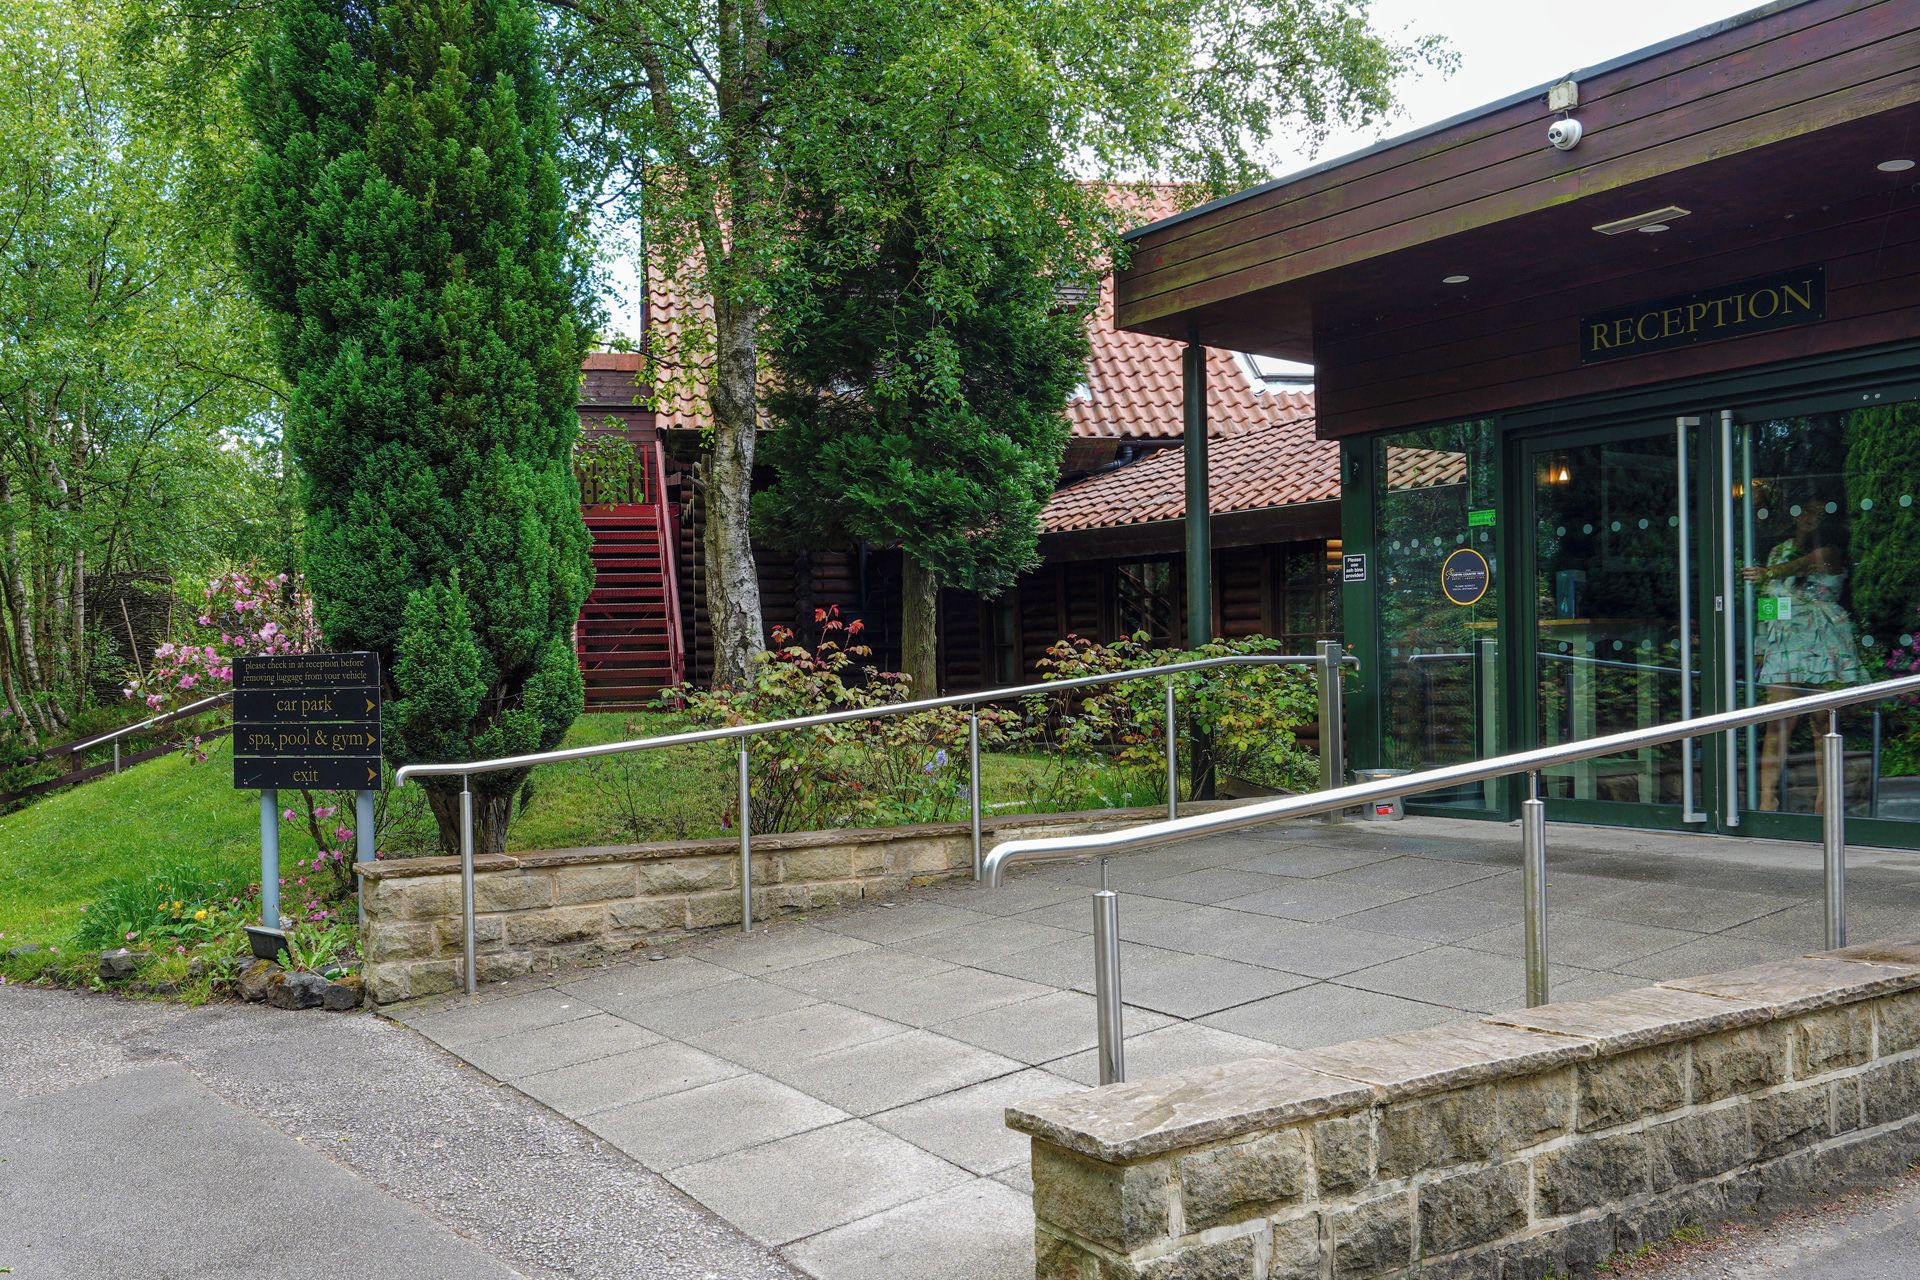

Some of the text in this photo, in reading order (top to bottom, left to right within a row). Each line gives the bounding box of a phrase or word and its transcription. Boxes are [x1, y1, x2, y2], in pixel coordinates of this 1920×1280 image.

[1591, 279, 1813, 351] RECEPTION
[245, 662, 266, 672] please
[267, 660, 287, 669] check
[306, 659, 339, 670] reception
[341, 657, 364, 667] before
[243, 670, 367, 683] removing luggage from your vehicle
[276, 694, 333, 716] car park
[248, 729, 363, 751] spa, pool & gym
[293, 765, 319, 782] exit
